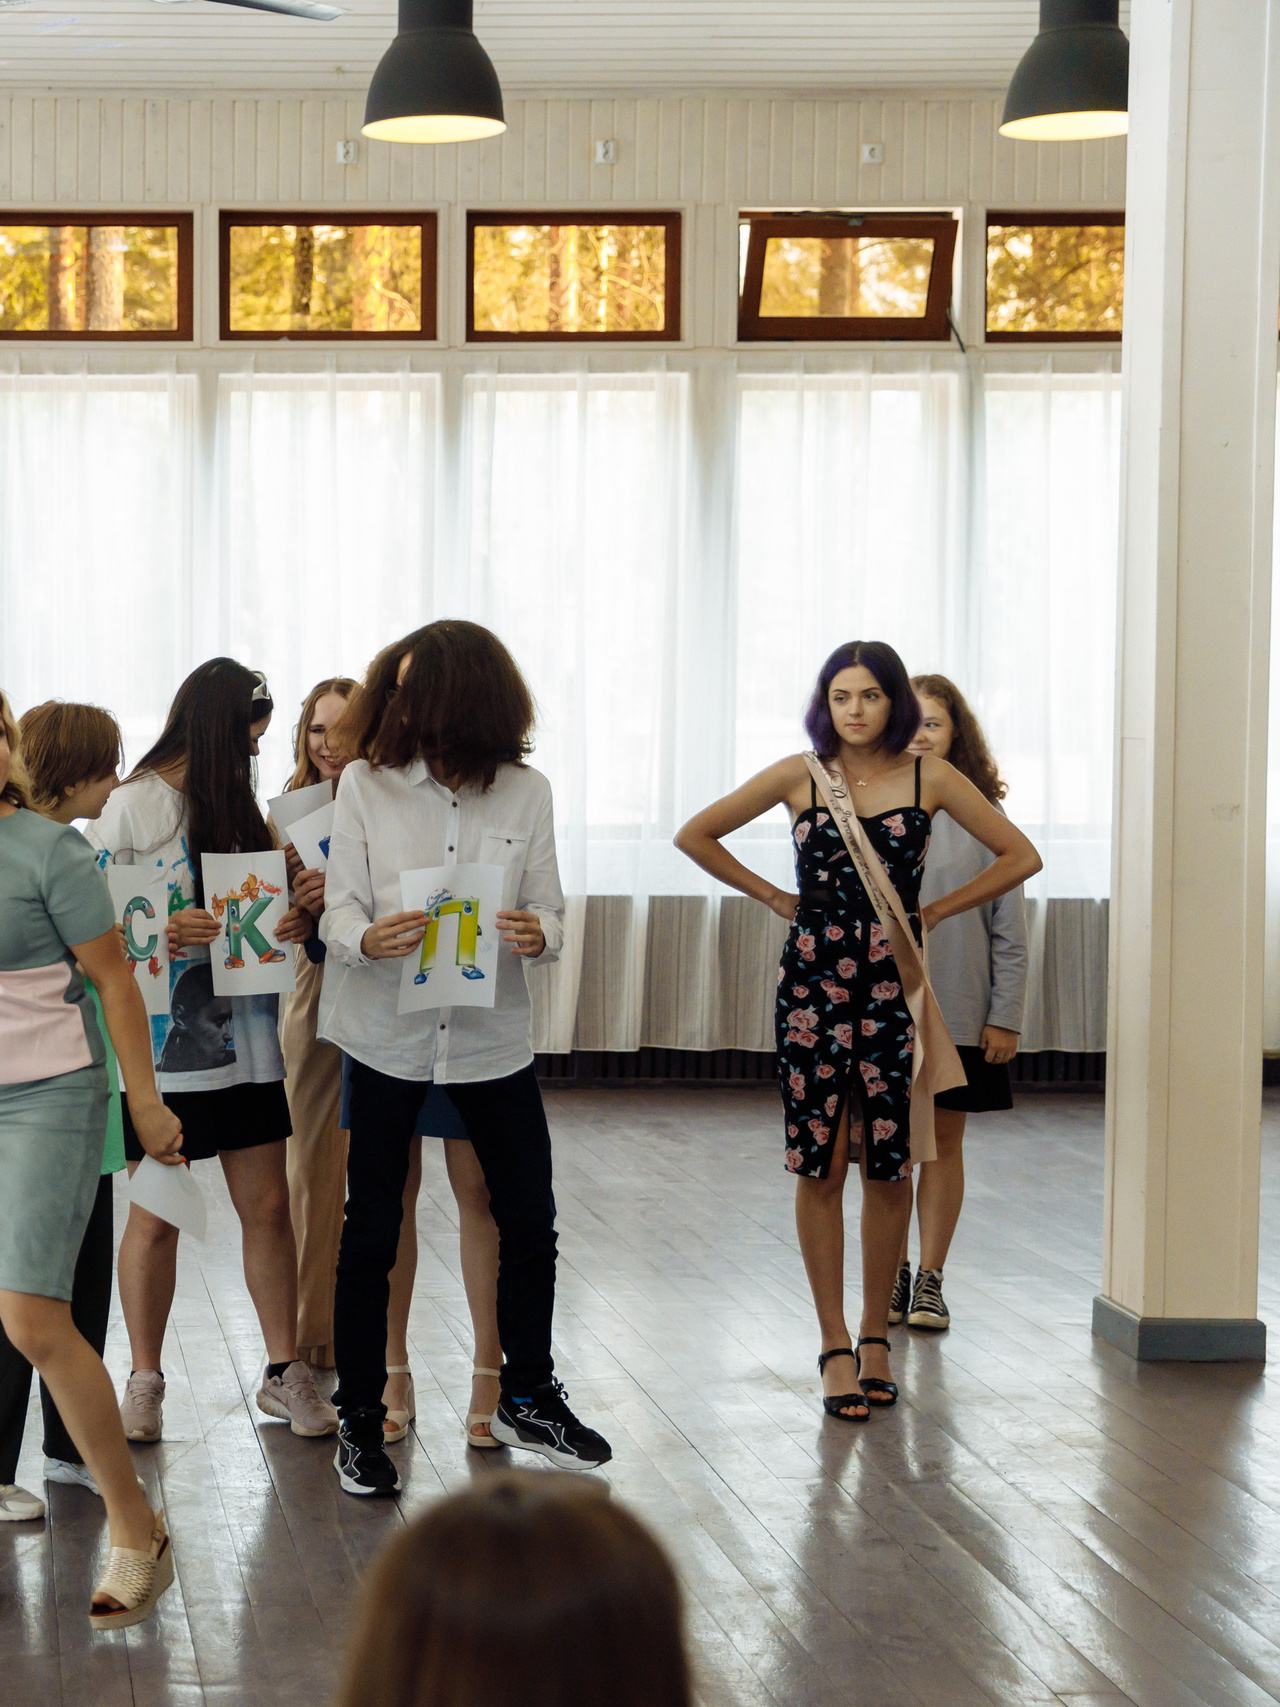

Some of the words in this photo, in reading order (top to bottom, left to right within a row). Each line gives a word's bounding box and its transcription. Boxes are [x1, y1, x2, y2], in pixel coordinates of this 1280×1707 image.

[123, 895, 158, 962] С
[226, 896, 275, 961] К
[419, 897, 480, 973] П
